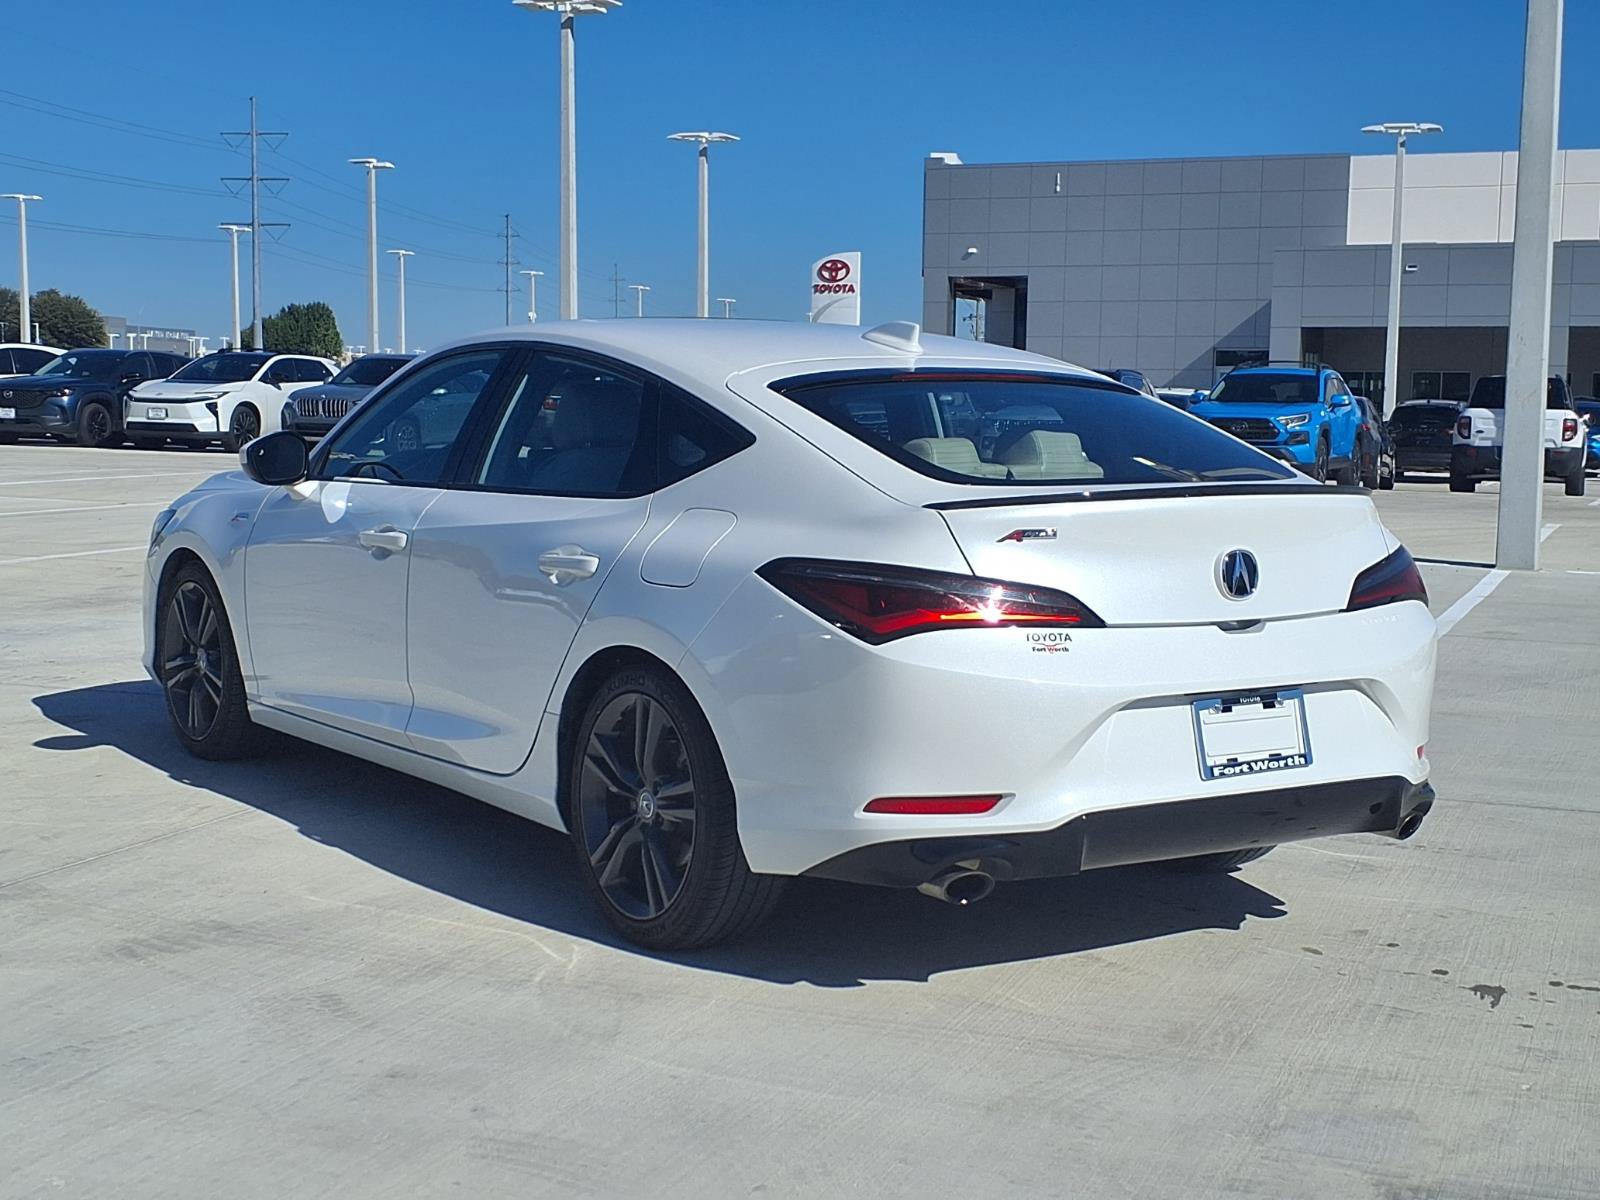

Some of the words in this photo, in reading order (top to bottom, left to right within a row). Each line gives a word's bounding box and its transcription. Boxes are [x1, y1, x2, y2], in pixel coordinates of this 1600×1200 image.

[812, 284, 856, 295] TOYOTA
[1026, 632, 1073, 642] TOYOTA
[1047, 645, 1070, 653] Worth
[1212, 761, 1250, 777] Fort
[1250, 755, 1306, 771] Worth
